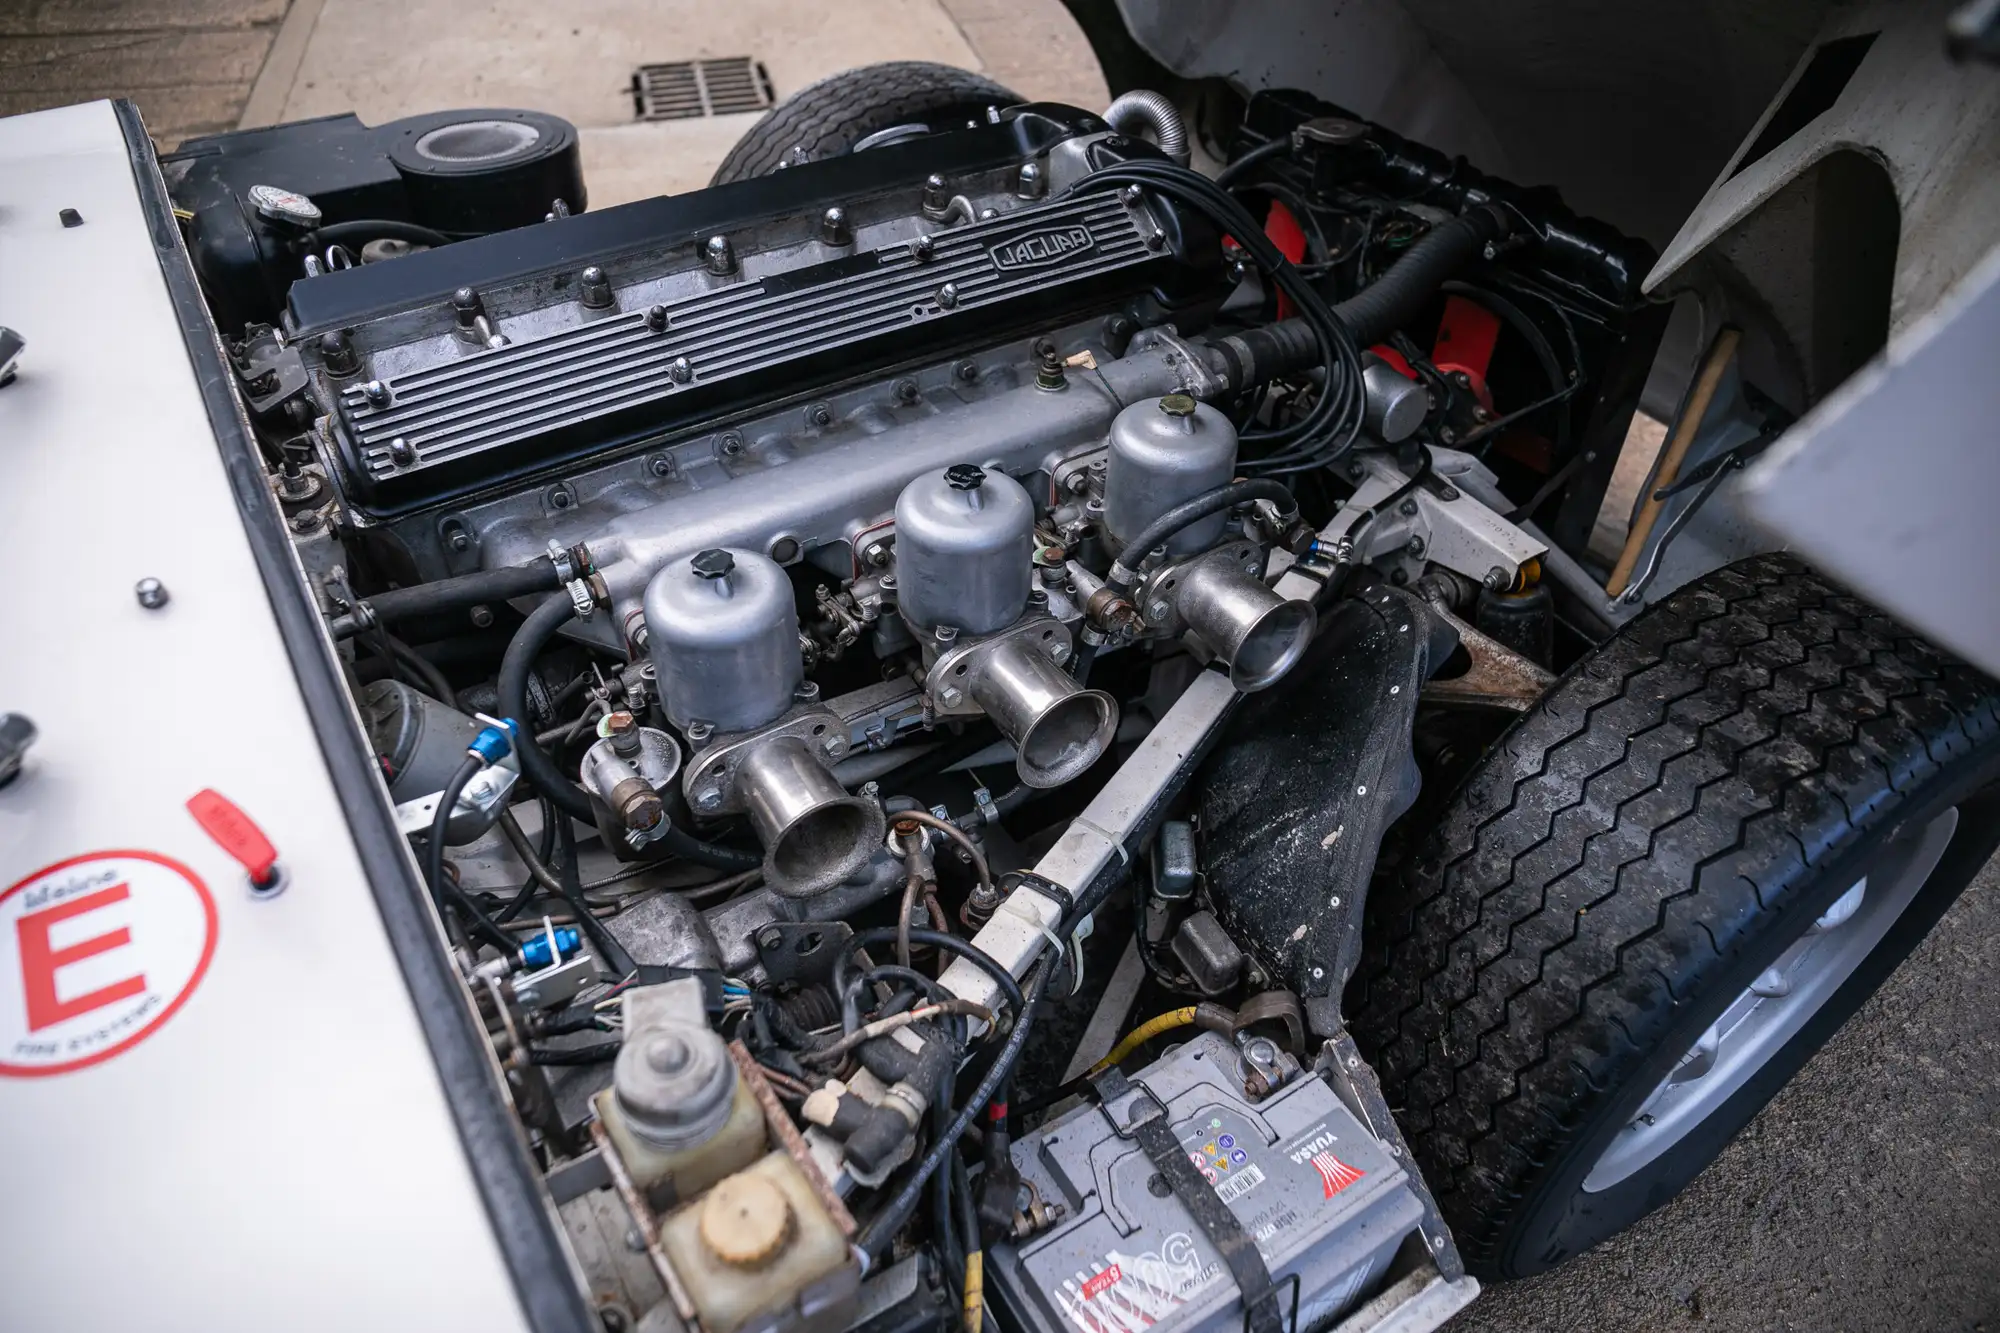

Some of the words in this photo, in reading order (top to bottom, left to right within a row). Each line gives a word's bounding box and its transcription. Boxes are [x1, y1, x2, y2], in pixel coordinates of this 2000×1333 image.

[1002, 230, 1087, 266] JAGUAR
[16, 881, 147, 1035] E
[1290, 1131, 1338, 1165] YUASA
